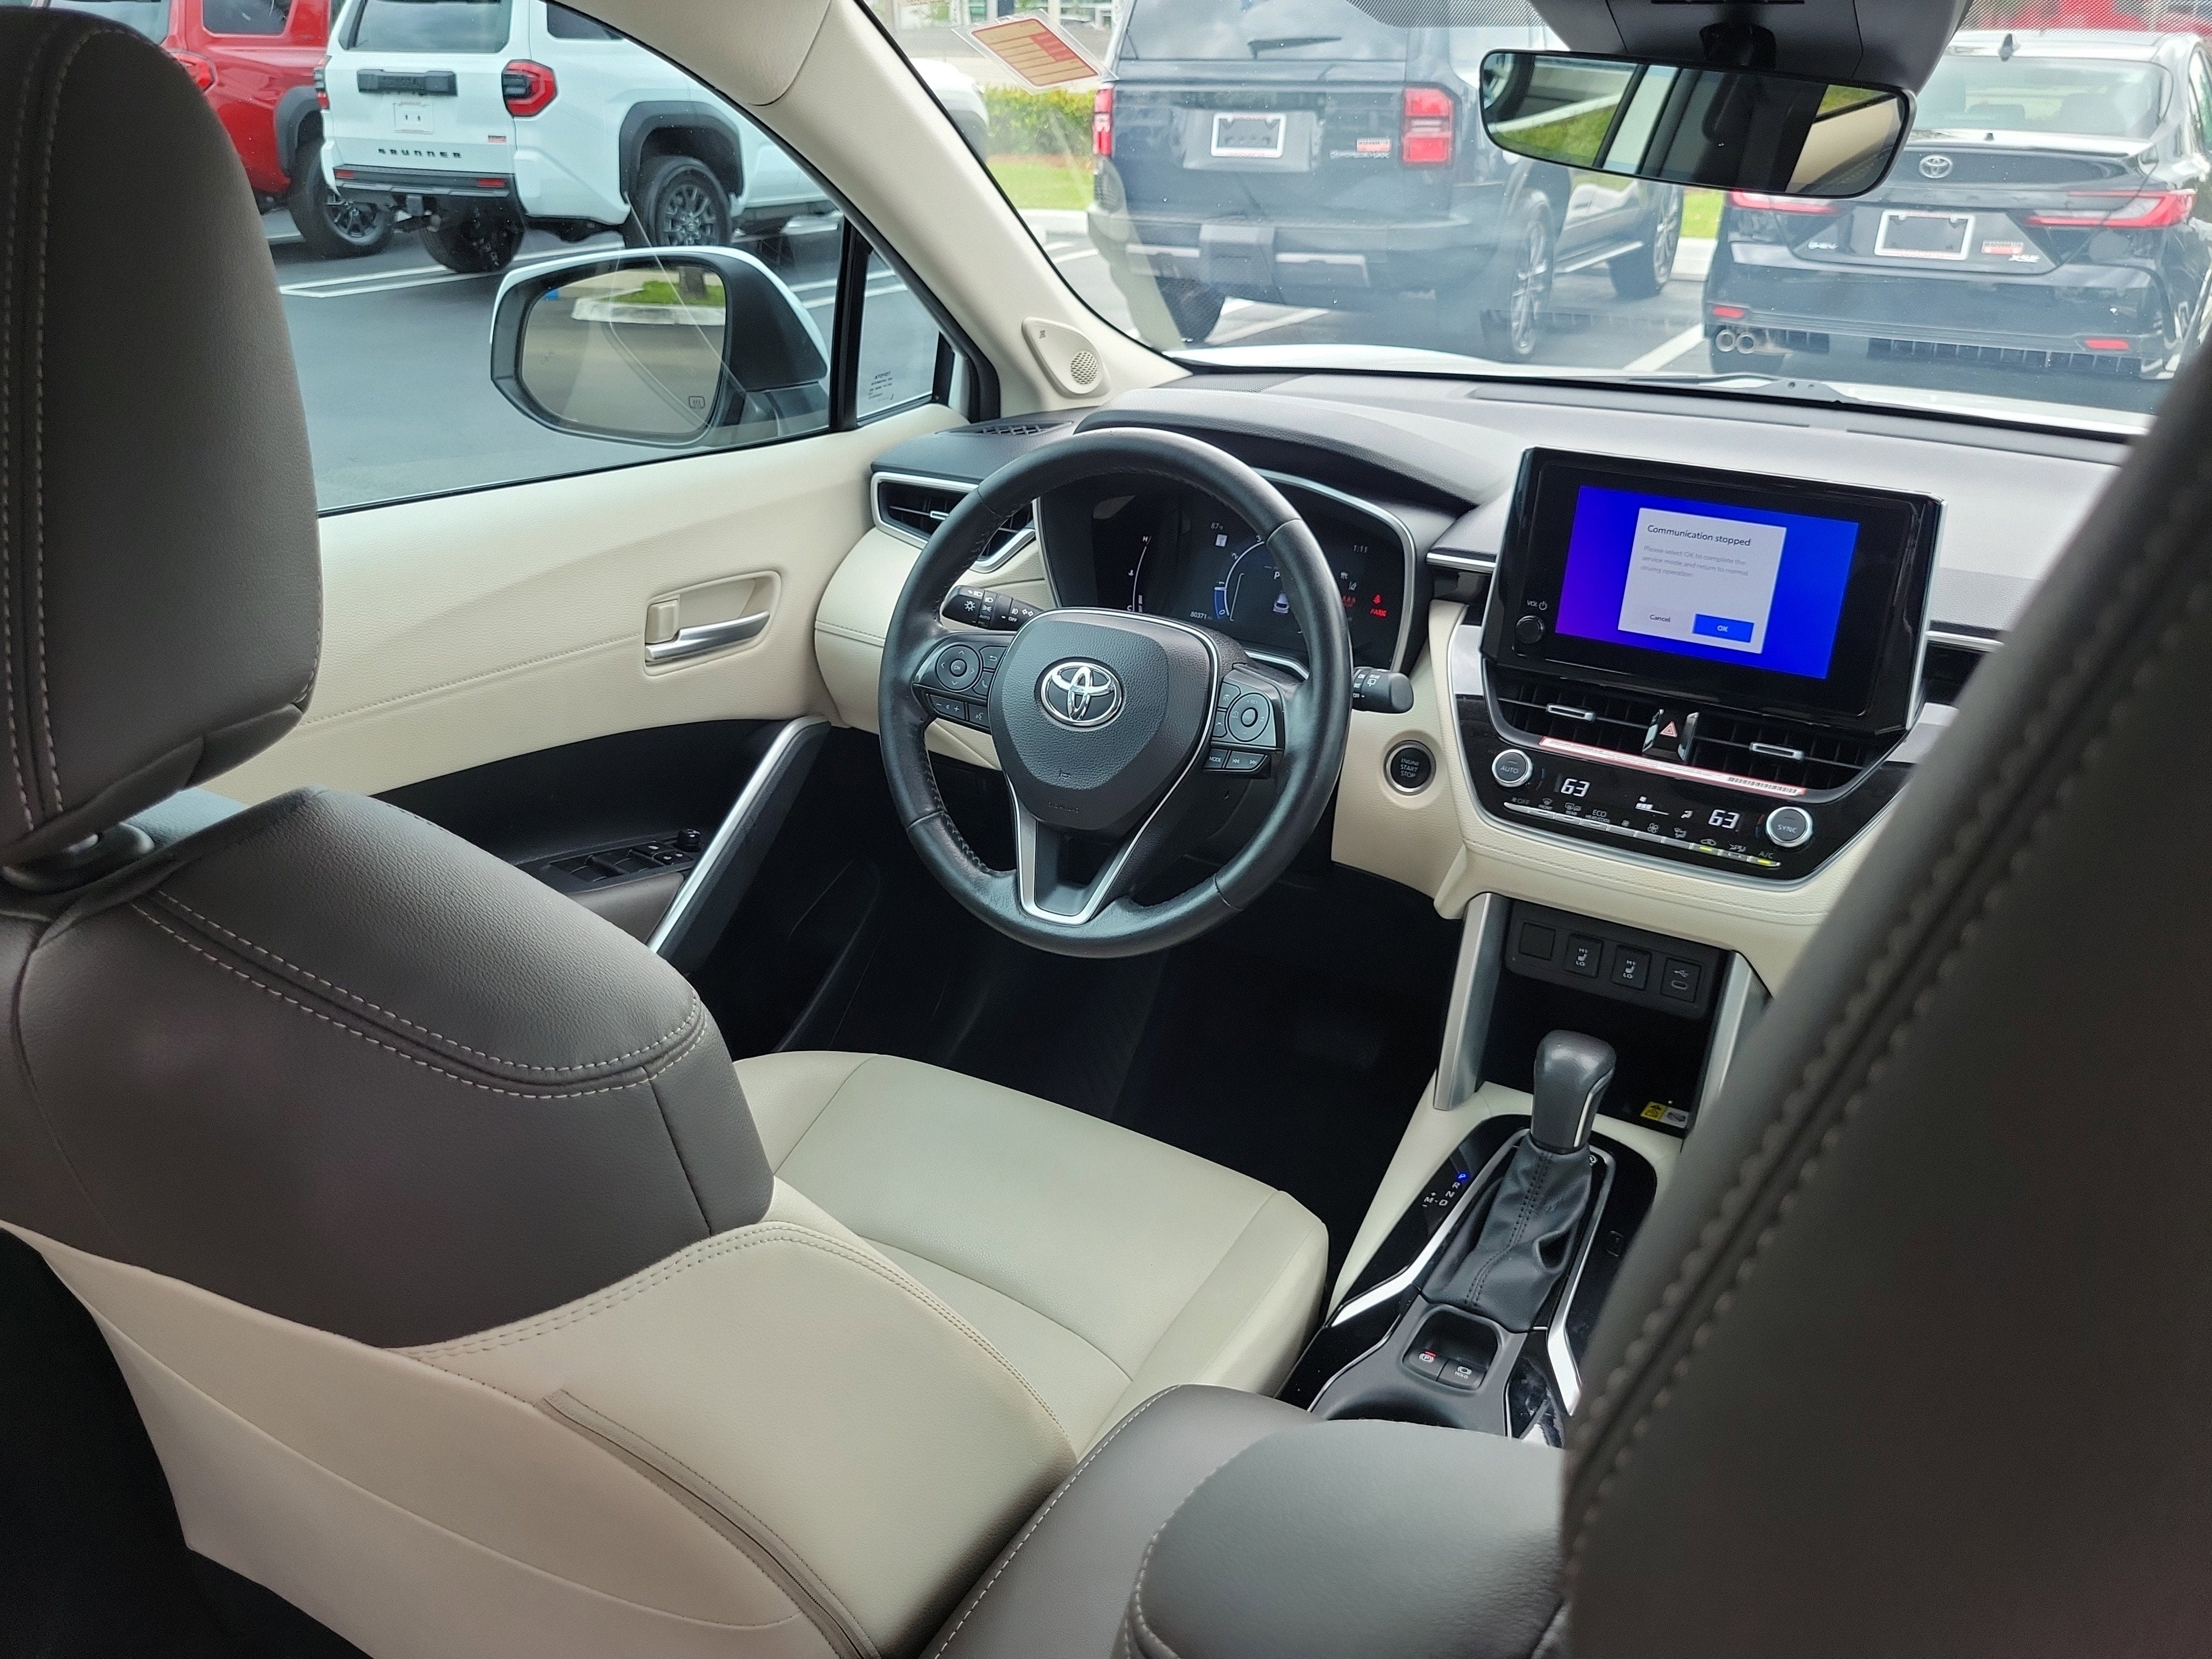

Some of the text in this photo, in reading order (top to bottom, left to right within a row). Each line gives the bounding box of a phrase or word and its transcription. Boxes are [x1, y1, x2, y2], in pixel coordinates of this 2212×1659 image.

[1256, 534, 1261, 543] 3
[1647, 525, 1751, 546] Communication stopped
[1643, 545, 1663, 554] Please
[1703, 555, 1734, 564] complete
[1640, 565, 1661, 574] driving
[1725, 568, 1748, 576] normal
[1273, 571, 1280, 580] P
[1649, 614, 1671, 623] Cancel
[1401, 758, 1420, 766] ENGINE
[1400, 764, 1418, 772] START
[1500, 765, 1519, 774] AUTO
[1560, 778, 1590, 797] 63
[1592, 809, 1607, 817] ECO
[1585, 814, 1610, 823] HEAT/COOL
[1708, 809, 1741, 829] 63
[1777, 824, 1798, 834] SYNC
[1758, 851, 1774, 859] A/C
